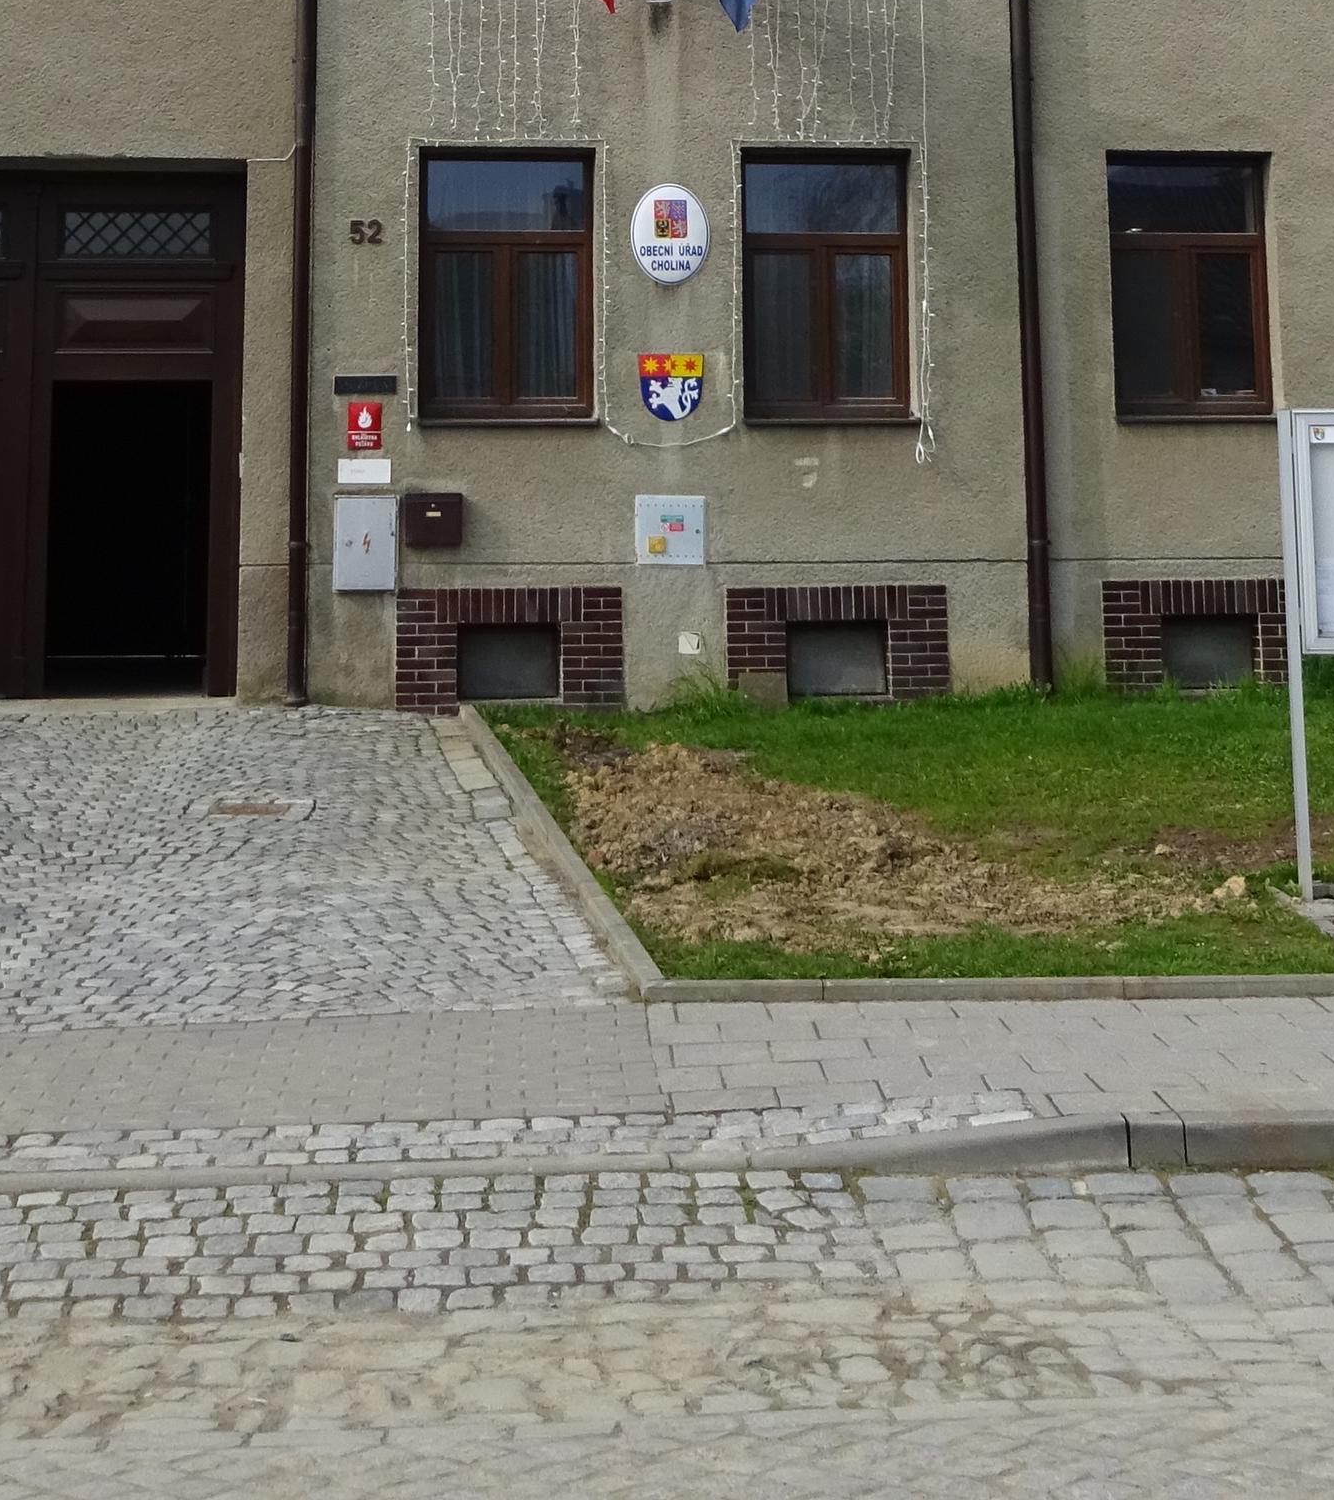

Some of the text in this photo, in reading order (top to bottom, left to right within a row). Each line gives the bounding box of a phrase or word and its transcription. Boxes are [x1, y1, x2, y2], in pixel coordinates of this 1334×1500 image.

[349, 219, 382, 244] 52
[639, 243, 703, 257] OBECNÍ ÚŘAD
[651, 260, 691, 271] CHOLINA
